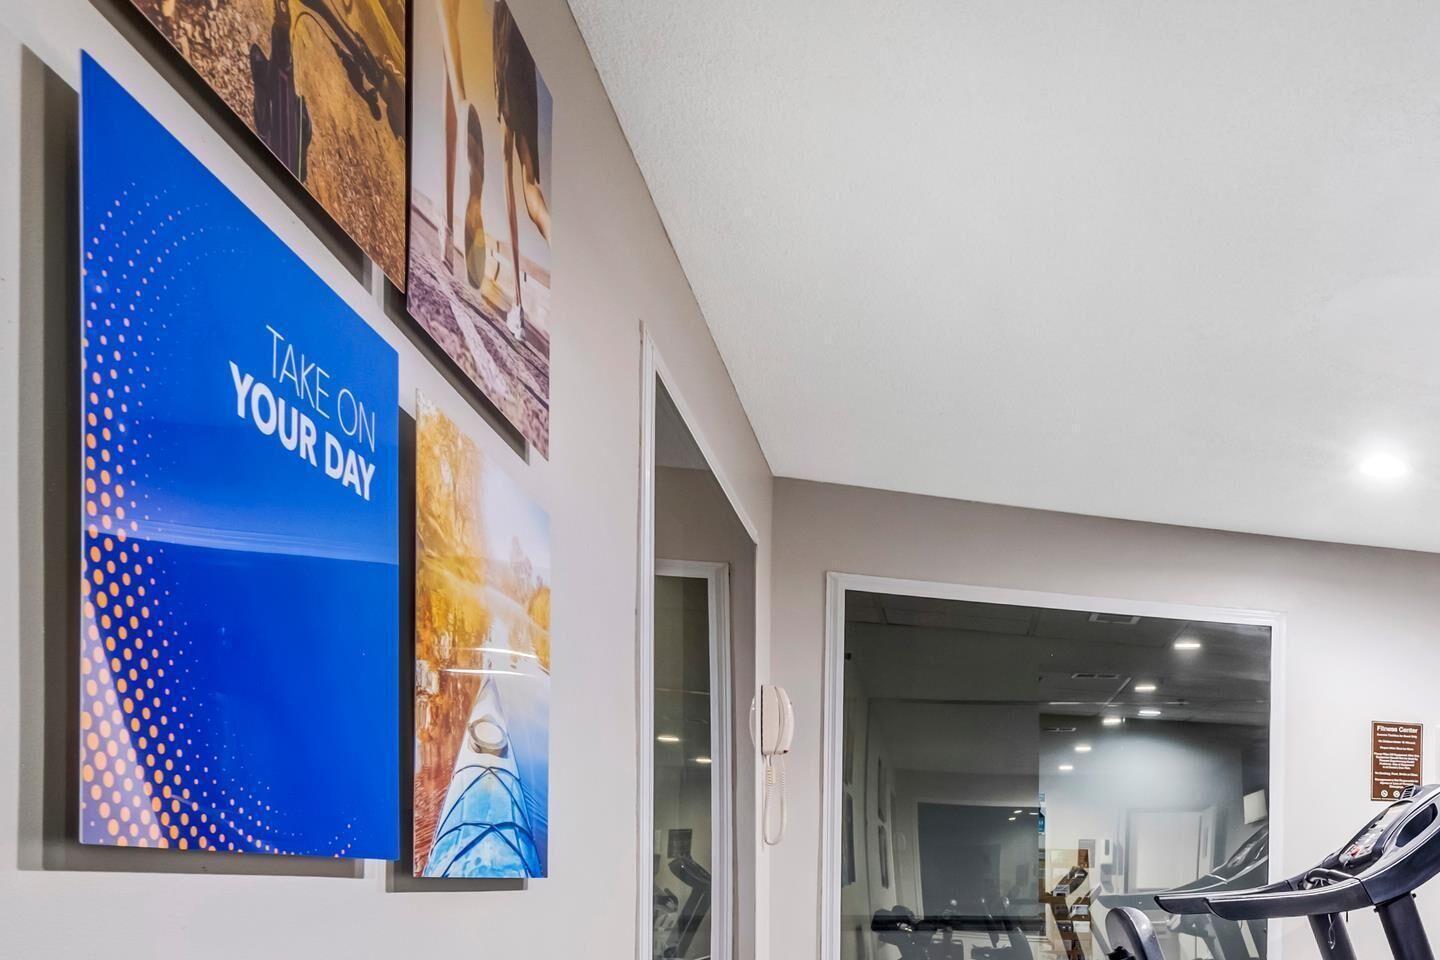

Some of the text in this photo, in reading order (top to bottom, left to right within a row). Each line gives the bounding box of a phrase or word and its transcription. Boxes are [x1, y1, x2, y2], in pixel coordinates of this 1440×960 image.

[229, 360, 375, 501] YOUR DAY
[266, 325, 376, 453] TAKE ON
[1399, 726, 1418, 734] Center
